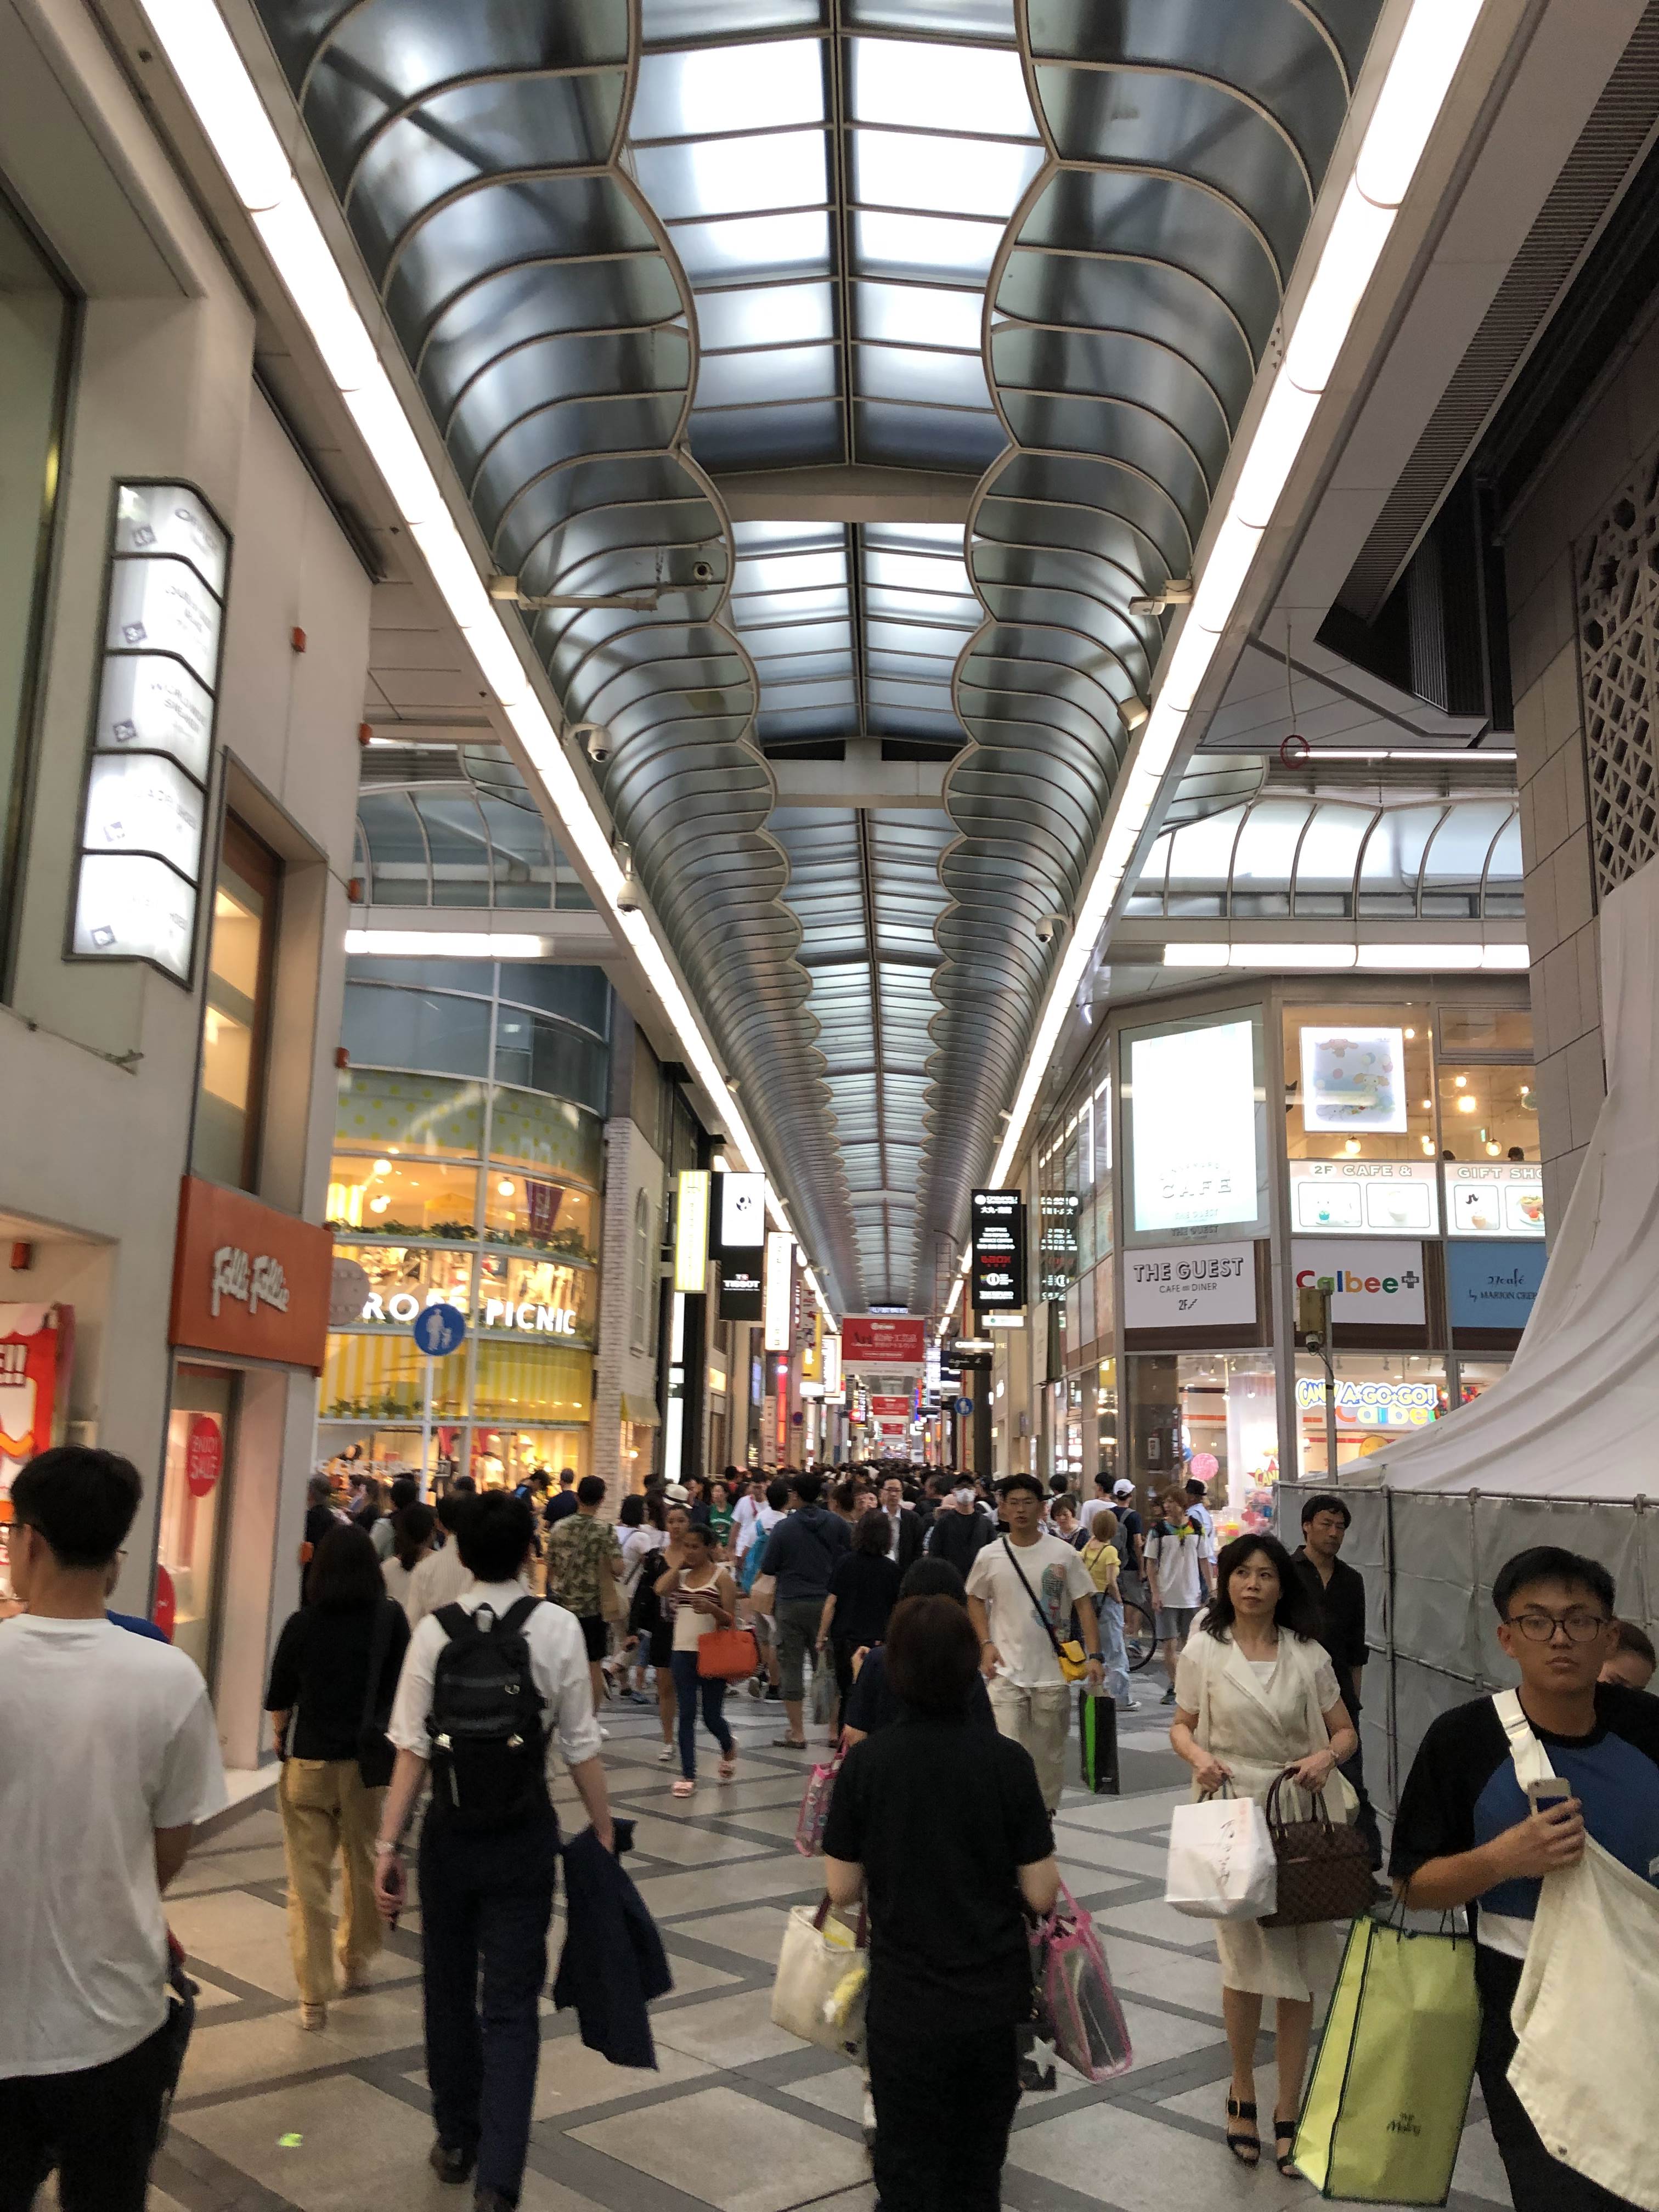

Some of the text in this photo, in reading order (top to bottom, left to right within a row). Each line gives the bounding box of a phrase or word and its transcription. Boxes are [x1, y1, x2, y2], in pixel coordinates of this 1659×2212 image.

[1314, 1165, 1412, 1177] 2F CAFE &
[1457, 1167, 1503, 1179] GIFT
[1162, 1180, 1232, 1199] CAFE
[1133, 1257, 1244, 1282] THE GUEST
[723, 1280, 760, 1288] TISSOT
[1159, 1285, 1181, 1293] CAFE
[1192, 1283, 1217, 1291] DINER
[1296, 1270, 1399, 1293] Calbee
[486, 1298, 576, 1335] PICNIC
